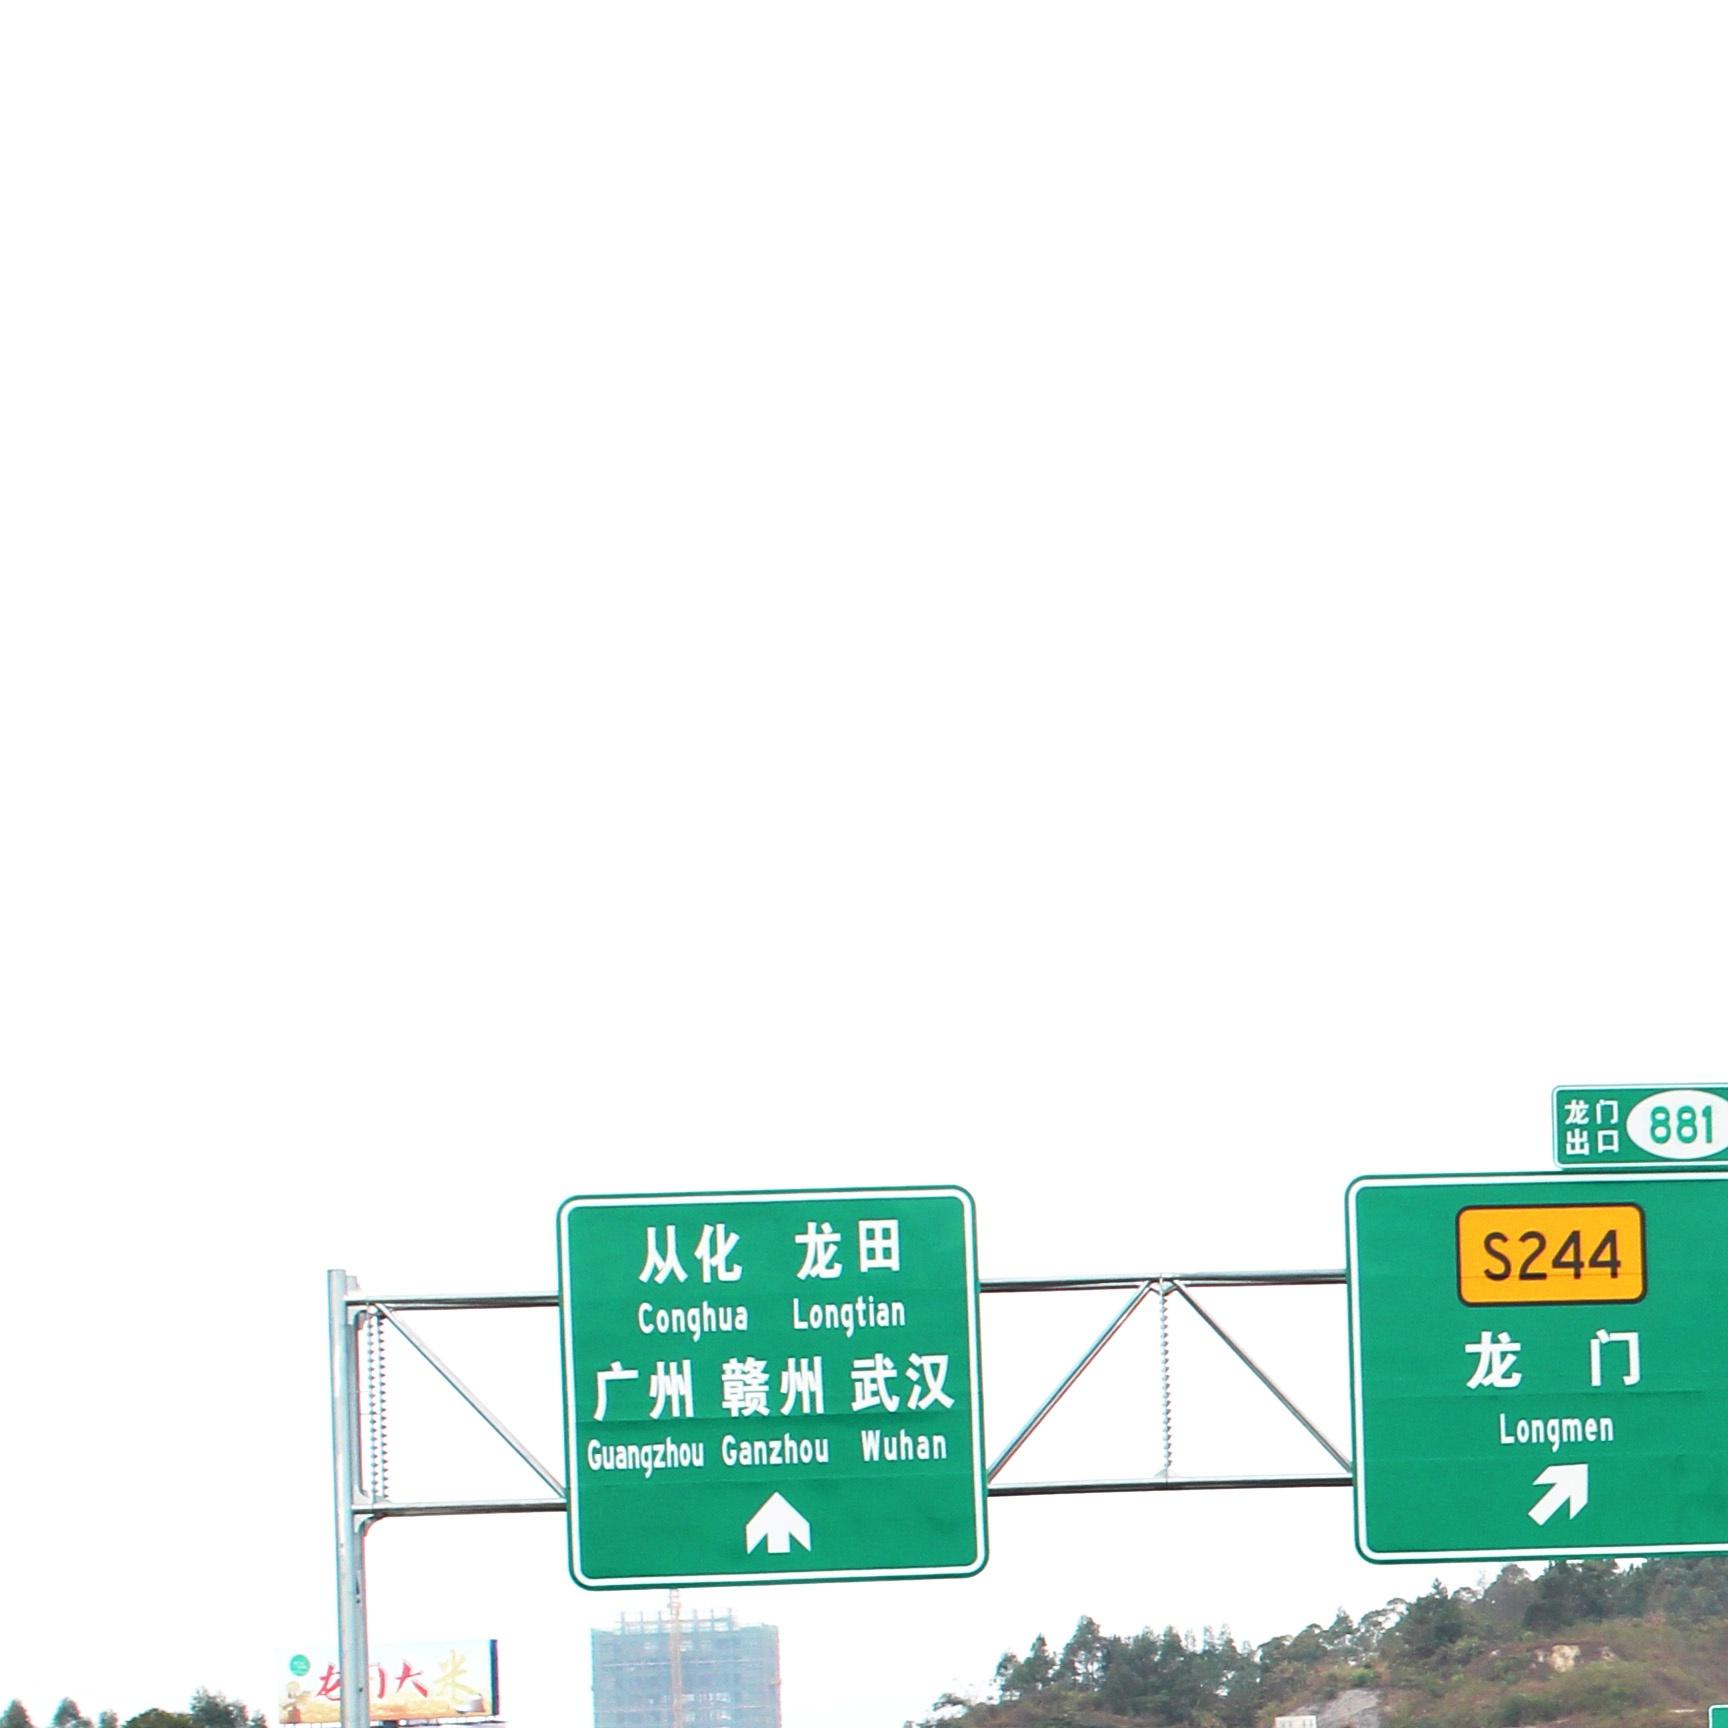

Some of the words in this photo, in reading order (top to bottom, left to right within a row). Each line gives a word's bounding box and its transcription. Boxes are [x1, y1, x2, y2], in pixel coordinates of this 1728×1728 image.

[1564, 1099, 1619, 1126] 龙门
[1649, 1104, 1714, 1145] 881
[1565, 1128, 1620, 1156] 出口
[637, 1222, 743, 1285] 从化
[794, 1218, 900, 1281] 龙田
[1482, 1228, 1622, 1282] S244
[637, 1301, 749, 1342] Conghua
[792, 1296, 906, 1338] Longtian
[1464, 1328, 1642, 1390] 龙门
[593, 1359, 695, 1422] 广州
[721, 1355, 825, 1418] 赣州
[850, 1352, 956, 1414] 武汉
[587, 1437, 704, 1478] Guangzhou
[721, 1432, 829, 1468] Ganzhou
[860, 1429, 948, 1463] Wuhan
[1499, 1412, 1614, 1453] Longmen
